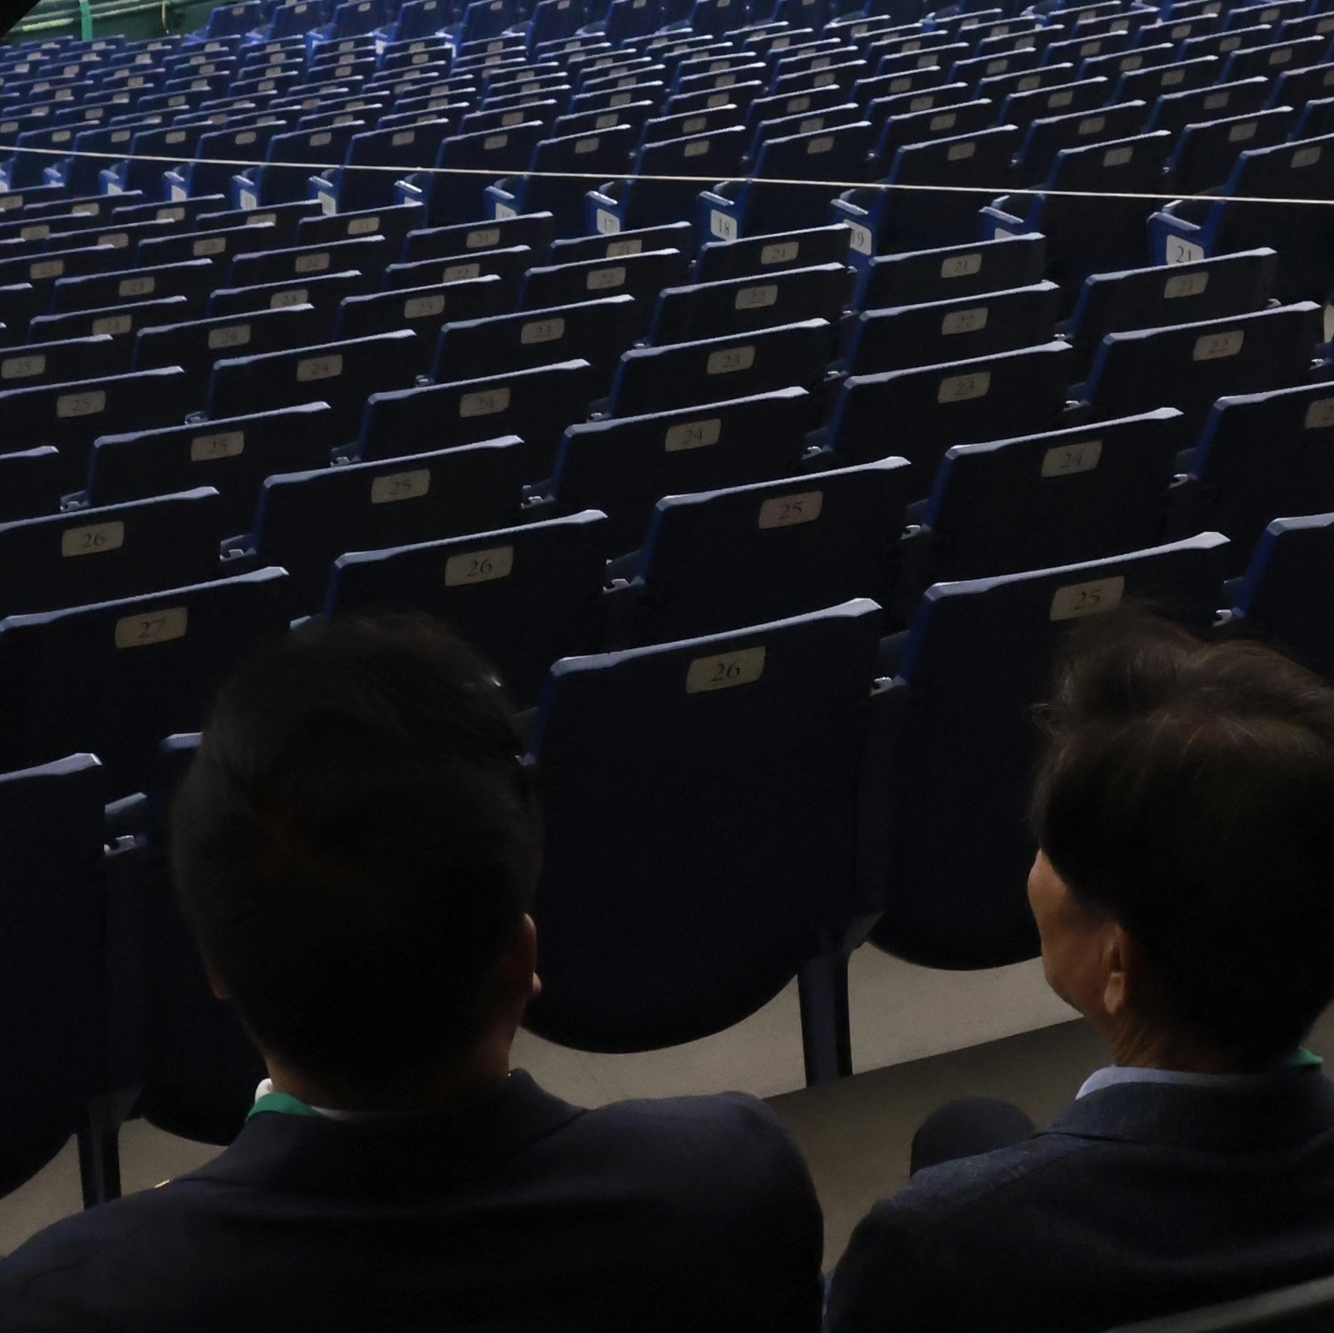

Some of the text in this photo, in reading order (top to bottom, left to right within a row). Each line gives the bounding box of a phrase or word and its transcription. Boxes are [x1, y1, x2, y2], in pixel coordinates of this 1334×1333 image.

[684, 429, 705, 444] 24
[208, 440, 229, 454] 25
[1059, 452, 1082, 468] 24
[390, 479, 412, 496] 25
[779, 501, 802, 519] 25
[82, 533, 105, 546] 26
[469, 559, 492, 576] 26
[1076, 591, 1100, 611] 25
[138, 620, 164, 637] 27
[712, 660, 741, 682] 26
